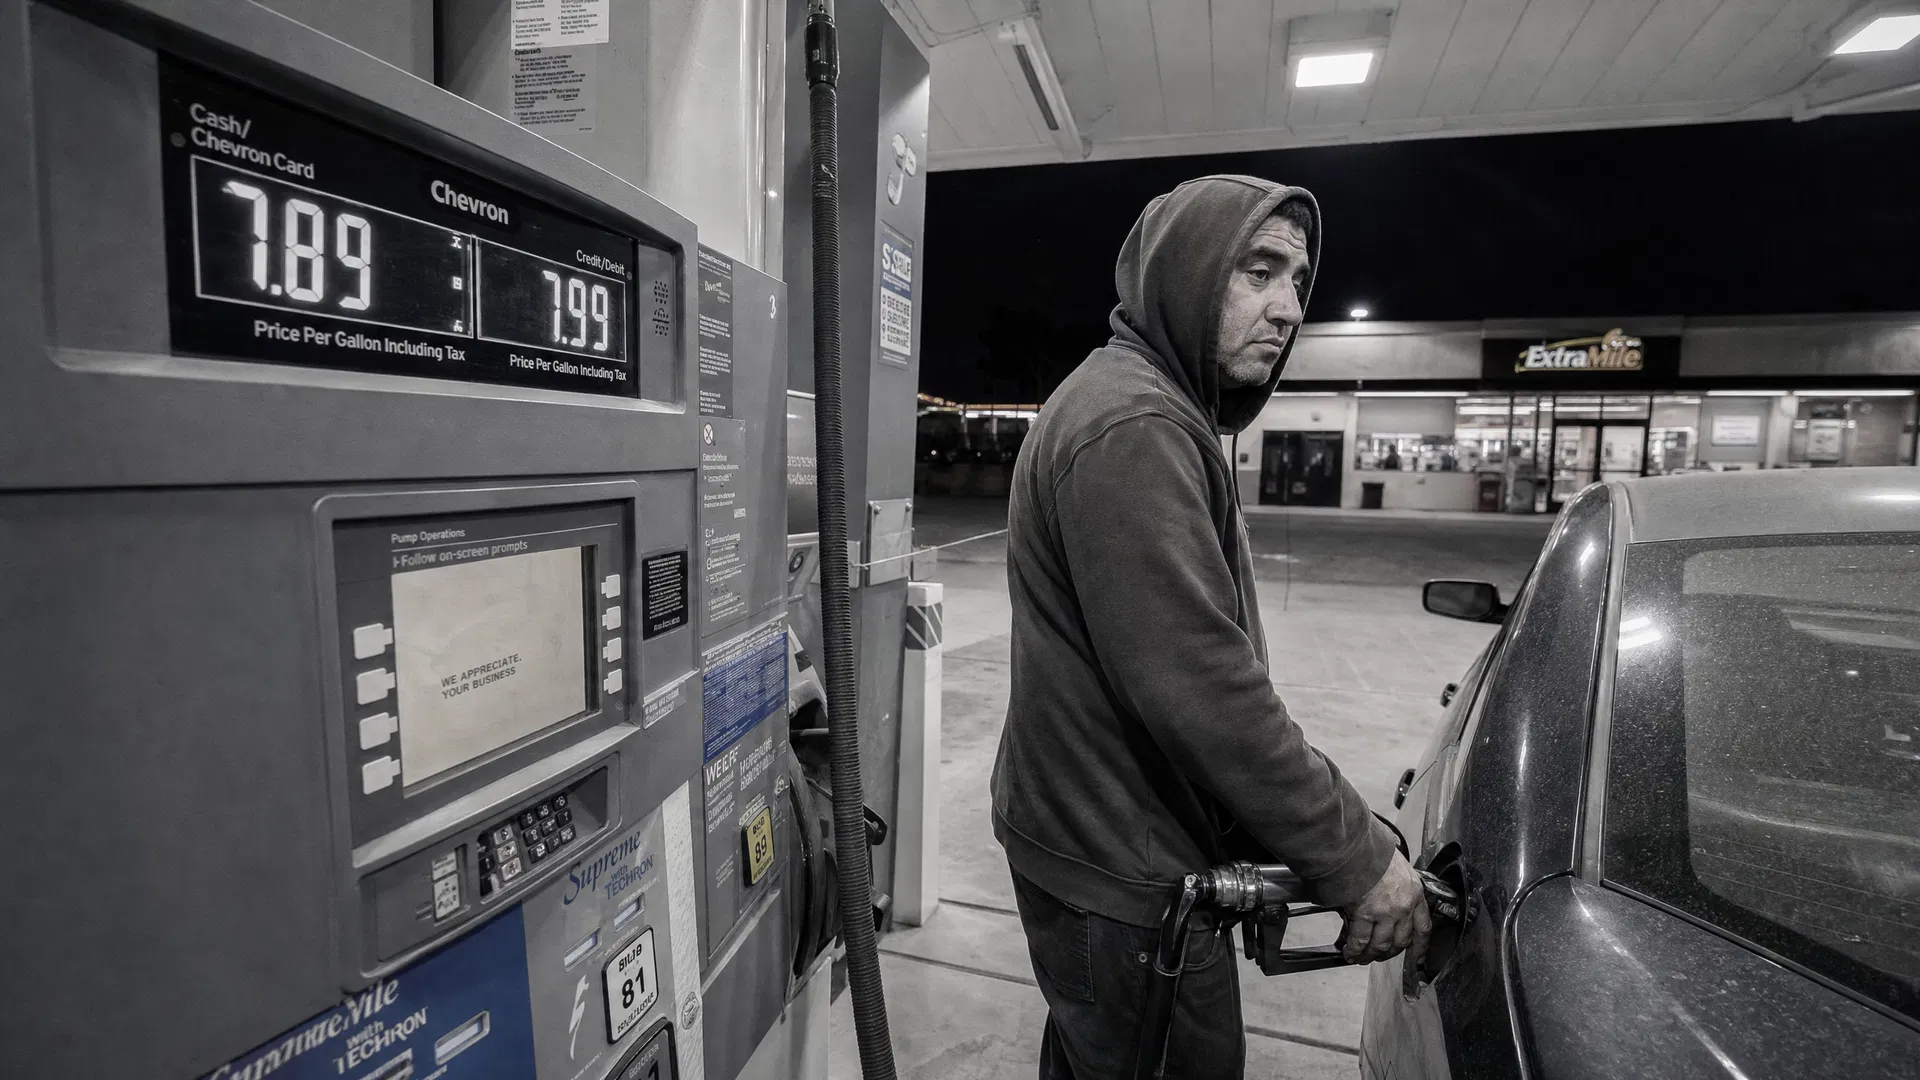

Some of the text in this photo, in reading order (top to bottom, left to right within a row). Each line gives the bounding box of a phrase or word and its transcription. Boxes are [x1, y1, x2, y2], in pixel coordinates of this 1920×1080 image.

[189, 103, 252, 139] Cash/
[191, 127, 315, 179] Chevron Card
[430, 180, 509, 225] Chevron
[223, 181, 371, 311] 7.89
[576, 250, 625, 276] Credit/Debit
[542, 270, 608, 351] 7.99
[769, 294, 777, 319] 3
[254, 320, 465, 361] Price Per Gallon Including Tax
[510, 354, 627, 382] Price Per Gallon Including Tax
[391, 528, 465, 545] Pump Operations
[439, 545, 489, 562] on-screen
[491, 540, 528, 557] prompts
[441, 675, 457, 688] WE
[442, 666, 516, 699] YOUR BUSINESS
[563, 830, 642, 905] Supreme
[604, 854, 654, 900] TECHRON
[611, 864, 628, 882] with
[622, 966, 646, 1009] 81
[332, 1008, 426, 1075] TECHRON
[346, 1020, 384, 1050] with
